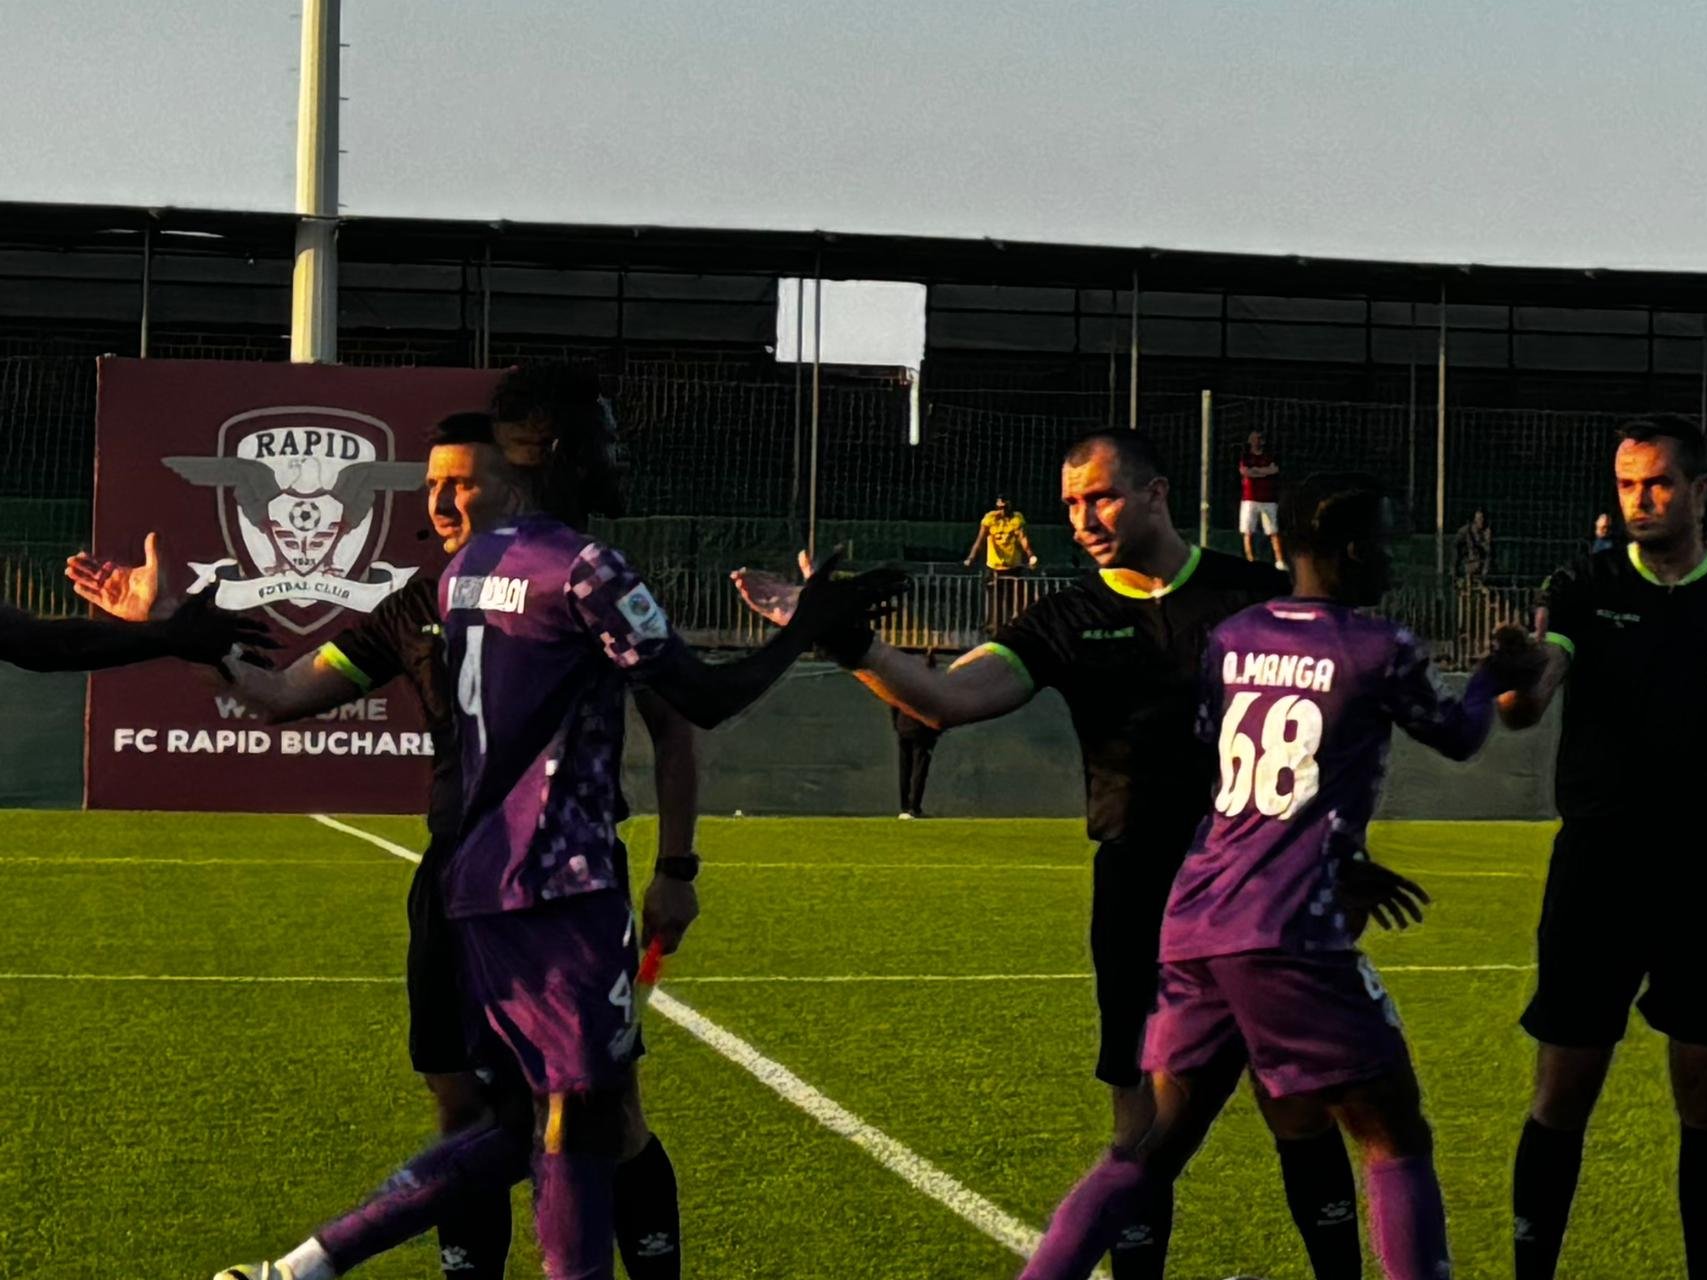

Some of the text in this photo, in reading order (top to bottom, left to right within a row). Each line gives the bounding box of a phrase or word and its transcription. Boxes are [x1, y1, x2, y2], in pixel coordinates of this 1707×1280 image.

[255, 431, 361, 459] RAPID
[314, 582, 350, 599] CLUB
[114, 729, 157, 753] FC
[167, 729, 271, 754] RAPID
[1214, 691, 1323, 820] 68
[608, 969, 632, 1023] 4
